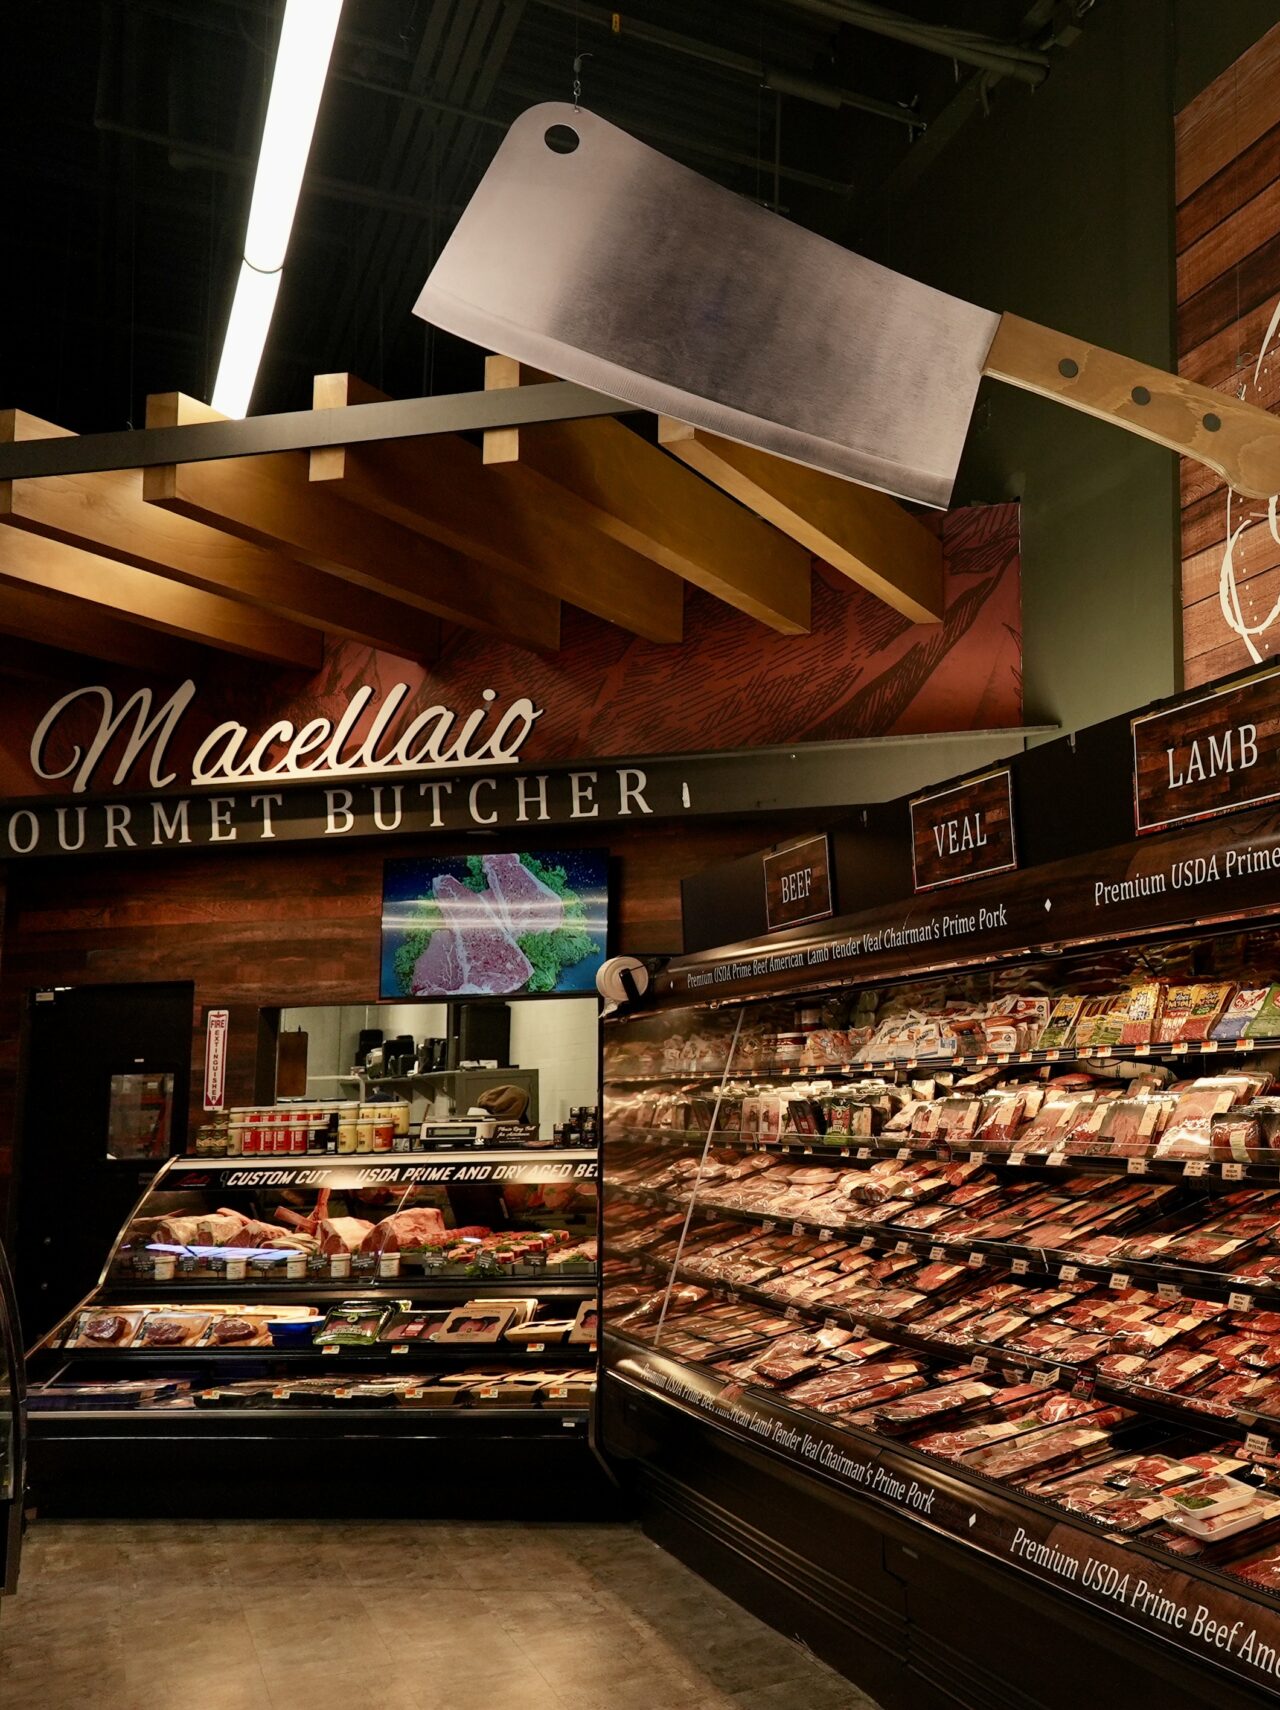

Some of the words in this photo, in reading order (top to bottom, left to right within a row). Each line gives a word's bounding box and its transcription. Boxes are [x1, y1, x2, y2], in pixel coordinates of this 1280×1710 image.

[29, 679, 543, 793] Macellaio
[1166, 723, 1258, 789] LAMB
[8, 795, 282, 854] OURMET
[324, 768, 653, 834] BUTCHER
[933, 813, 987, 857] VEAL
[781, 868, 812, 904] BEEF
[1094, 872, 1166, 906] Premium
[1171, 855, 1220, 889] USDA
[687, 971, 713, 988] Premium
[714, 966, 732, 983] USDA
[732, 963, 752, 980] Prime
[753, 957, 768, 976] Beef
[769, 952, 804, 973] American
[807, 943, 829, 965] Lamb
[831, 937, 861, 959] Tender
[863, 930, 882, 953] Veal
[883, 918, 940, 949] Chairman's
[942, 914, 976, 937] Prime
[979, 904, 1008, 930] Pork
[210, 1019, 225, 1028] FIRE
[211, 1029, 220, 1101] EXTINGUISHER
[227, 1170, 296, 1186] CUSTOM
[295, 1169, 332, 1184] CUT
[356, 1167, 401, 1183] USDA
[402, 1166, 455, 1181] PRIME
[453, 1166, 491, 1180] AND
[492, 1165, 528, 1179] DRY
[525, 1164, 573, 1178] AGED
[749, 1412, 773, 1438] Lamb
[771, 1421, 801, 1450] Tender
[801, 1434, 823, 1462] Veal
[819, 1444, 873, 1485] Chairman's
[872, 1468, 907, 1500] Prime
[906, 1482, 936, 1514] Pork
[1010, 1527, 1079, 1580] Premium
[1082, 1557, 1130, 1603] USDA
[1130, 1580, 1188, 1629] Prime
[1189, 1605, 1244, 1653] Beef
